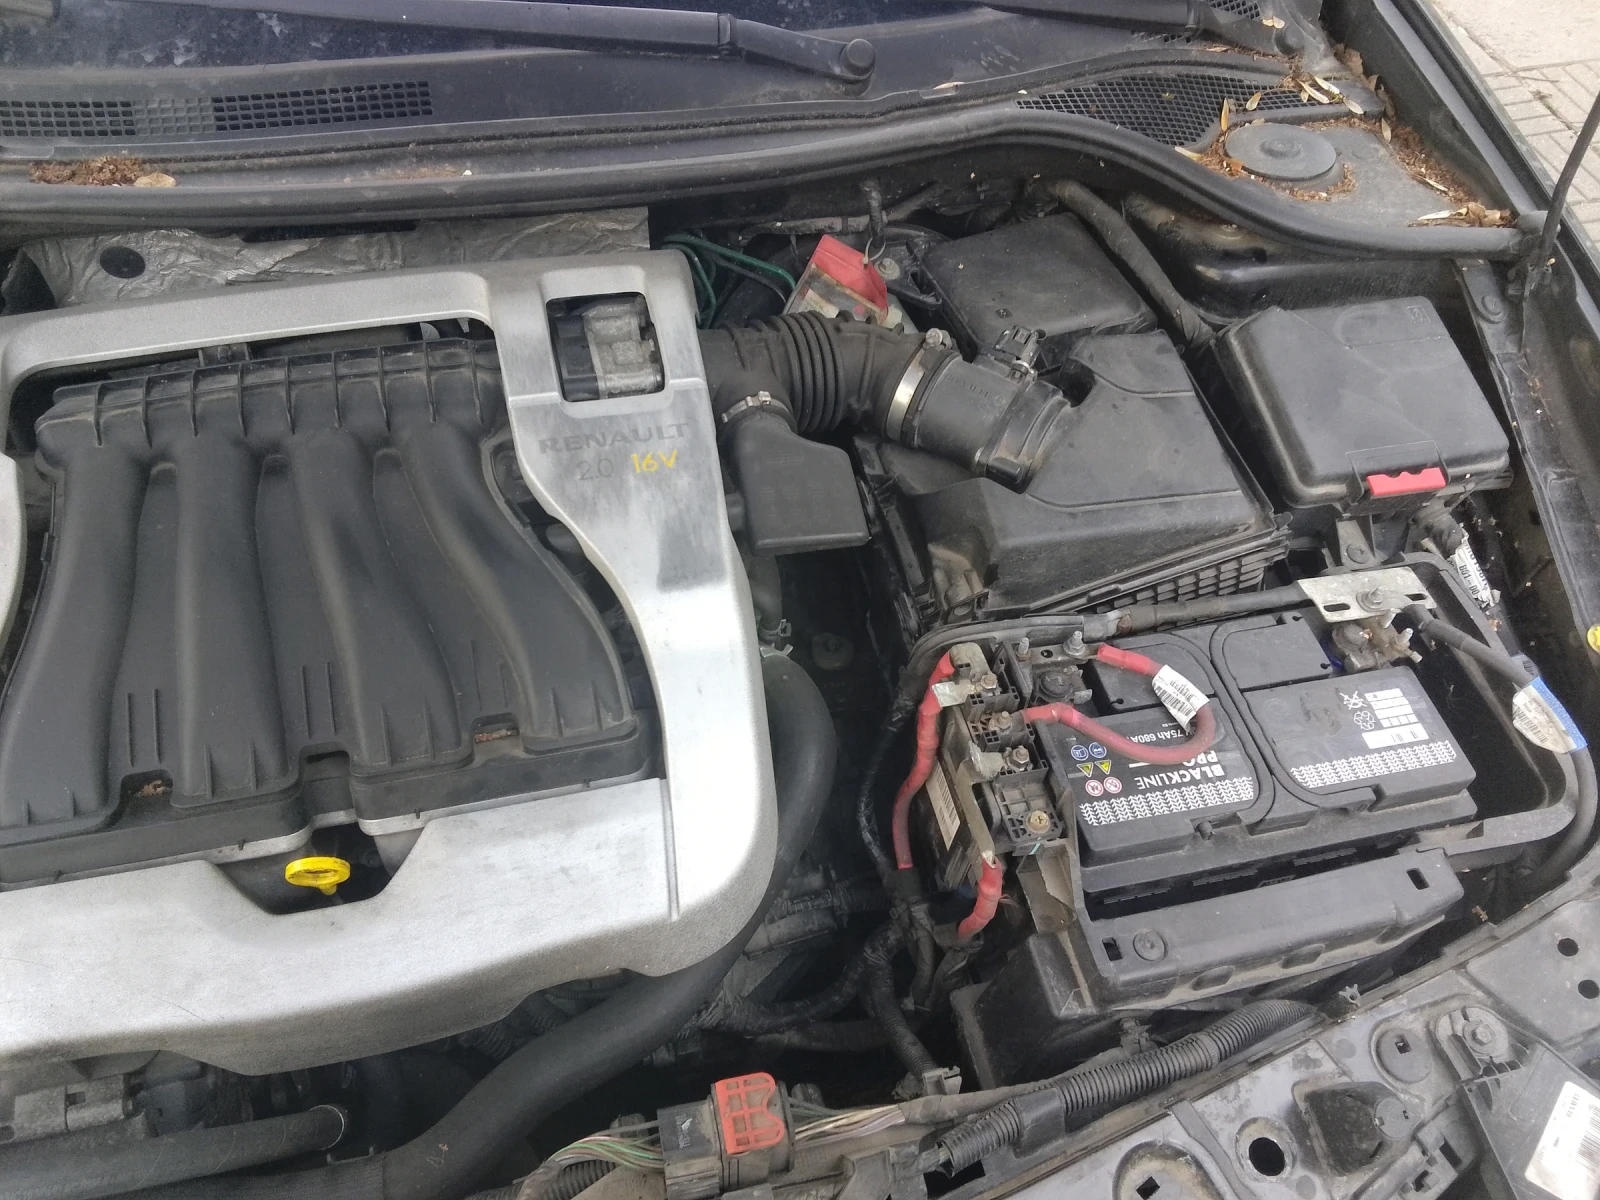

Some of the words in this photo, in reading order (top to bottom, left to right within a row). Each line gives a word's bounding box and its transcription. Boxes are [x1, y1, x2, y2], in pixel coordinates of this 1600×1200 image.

[537, 422, 689, 454] RENAULT
[577, 458, 615, 481] 2.0
[631, 449, 678, 474] 16V
[1130, 732, 1156, 743] 680A
[1157, 728, 1183, 740] 75Ah
[1134, 763, 1226, 790] BLACKLINE
